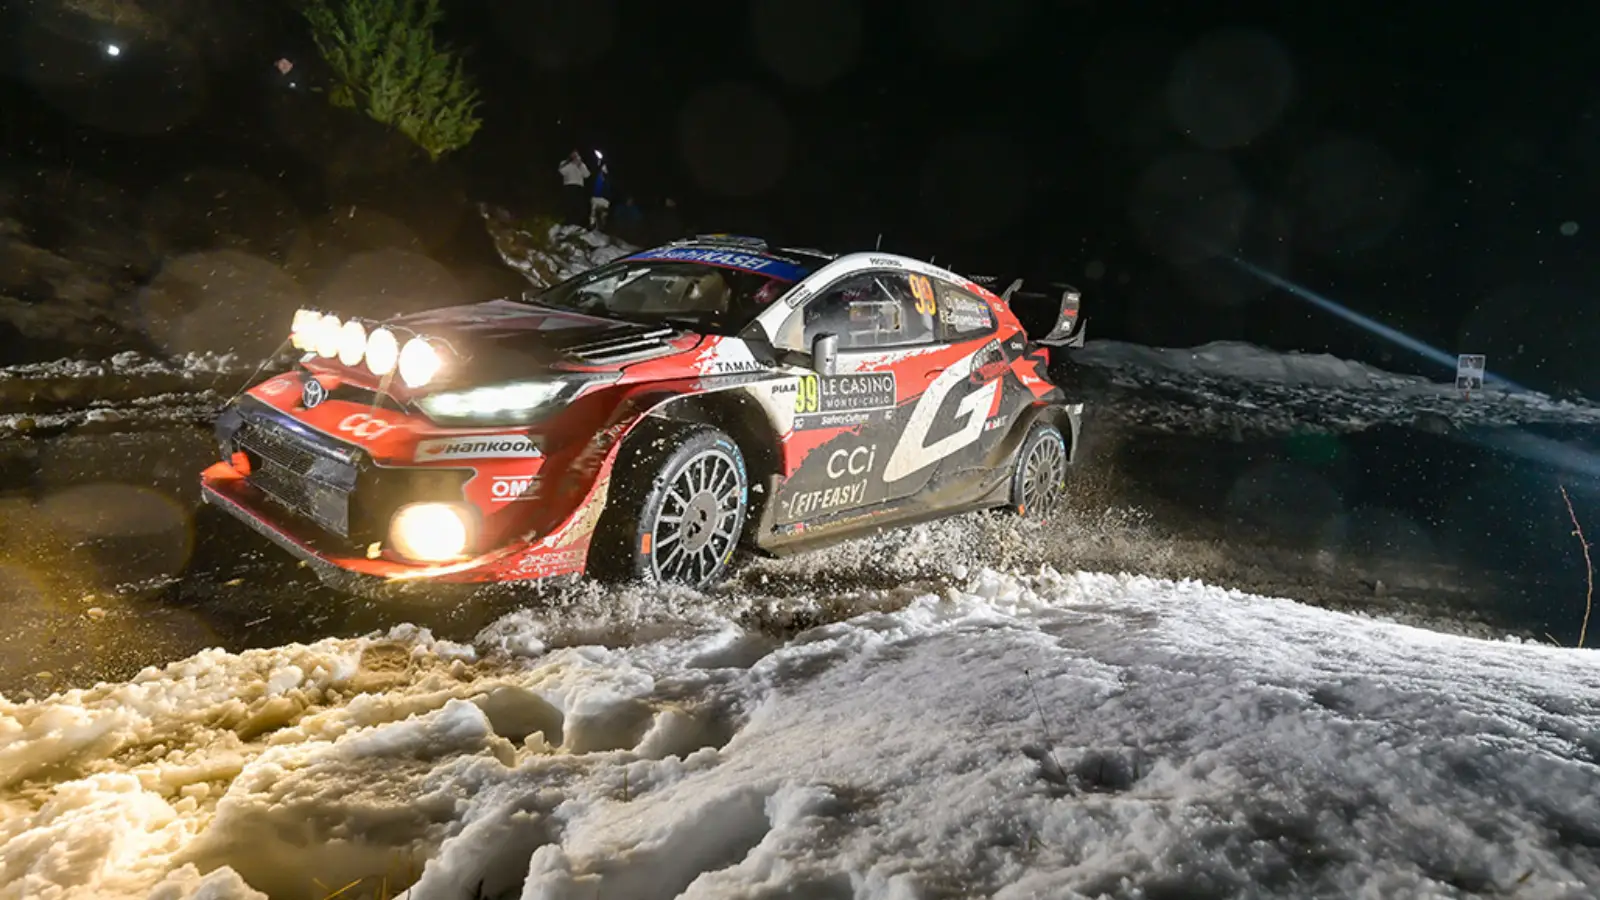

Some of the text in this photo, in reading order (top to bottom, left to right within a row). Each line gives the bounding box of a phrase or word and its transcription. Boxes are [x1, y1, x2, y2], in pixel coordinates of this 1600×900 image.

[908, 274, 936, 316] 99
[772, 384, 796, 395] PIAA
[822, 376, 893, 396] LE CASINO
